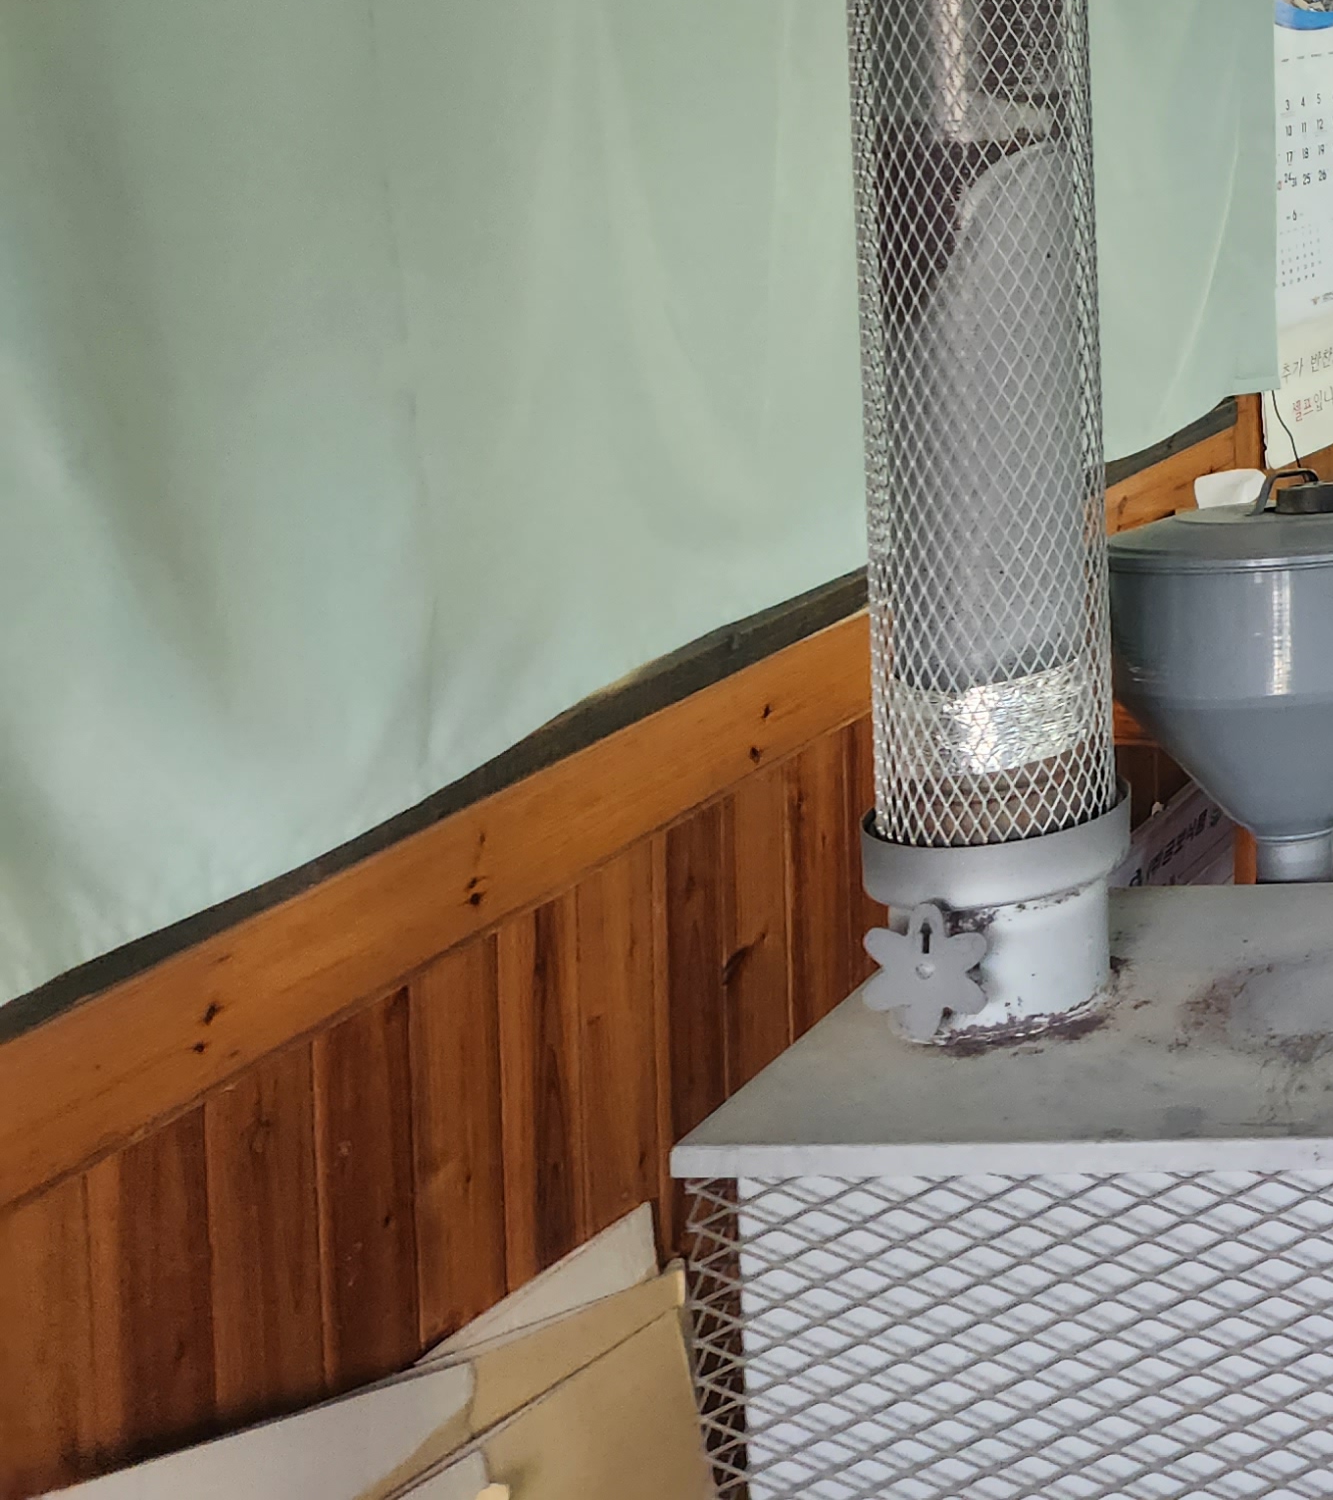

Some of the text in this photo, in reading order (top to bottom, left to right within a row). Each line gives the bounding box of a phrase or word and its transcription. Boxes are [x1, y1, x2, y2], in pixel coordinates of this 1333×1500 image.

[1285, 125, 1292, 137] 10
[1301, 122, 1307, 133] 11
[1316, 118, 1324, 130] 12
[1286, 151, 1293, 163] 17
[1302, 147, 1309, 160] 18
[1318, 144, 1325, 156] 19
[1302, 173, 1311, 186] 25
[1318, 169, 1327, 182] 26
[1282, 357, 1304, 384] 추가
